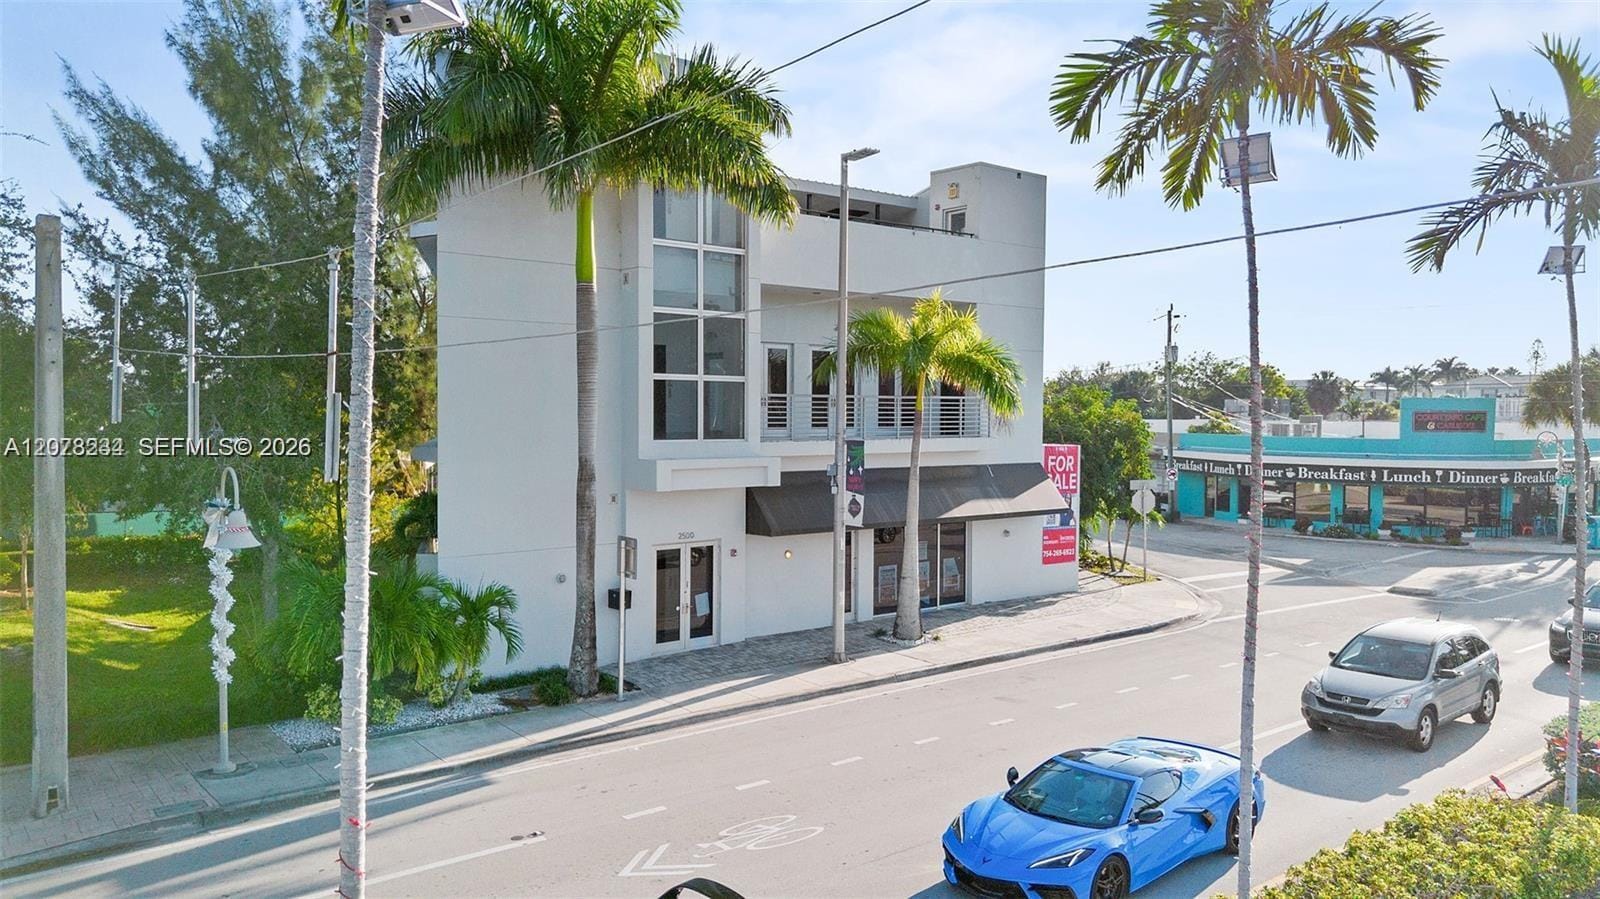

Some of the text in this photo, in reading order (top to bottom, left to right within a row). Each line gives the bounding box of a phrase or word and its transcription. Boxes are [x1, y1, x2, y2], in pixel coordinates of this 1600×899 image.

[1048, 456, 1074, 472] FOR
[1048, 473, 1077, 490] ALE
[1209, 463, 1235, 475] Lunch
[1298, 467, 1366, 481] Breakfast
[1382, 469, 1432, 482] Lunch
[1448, 470, 1498, 484] Dinner
